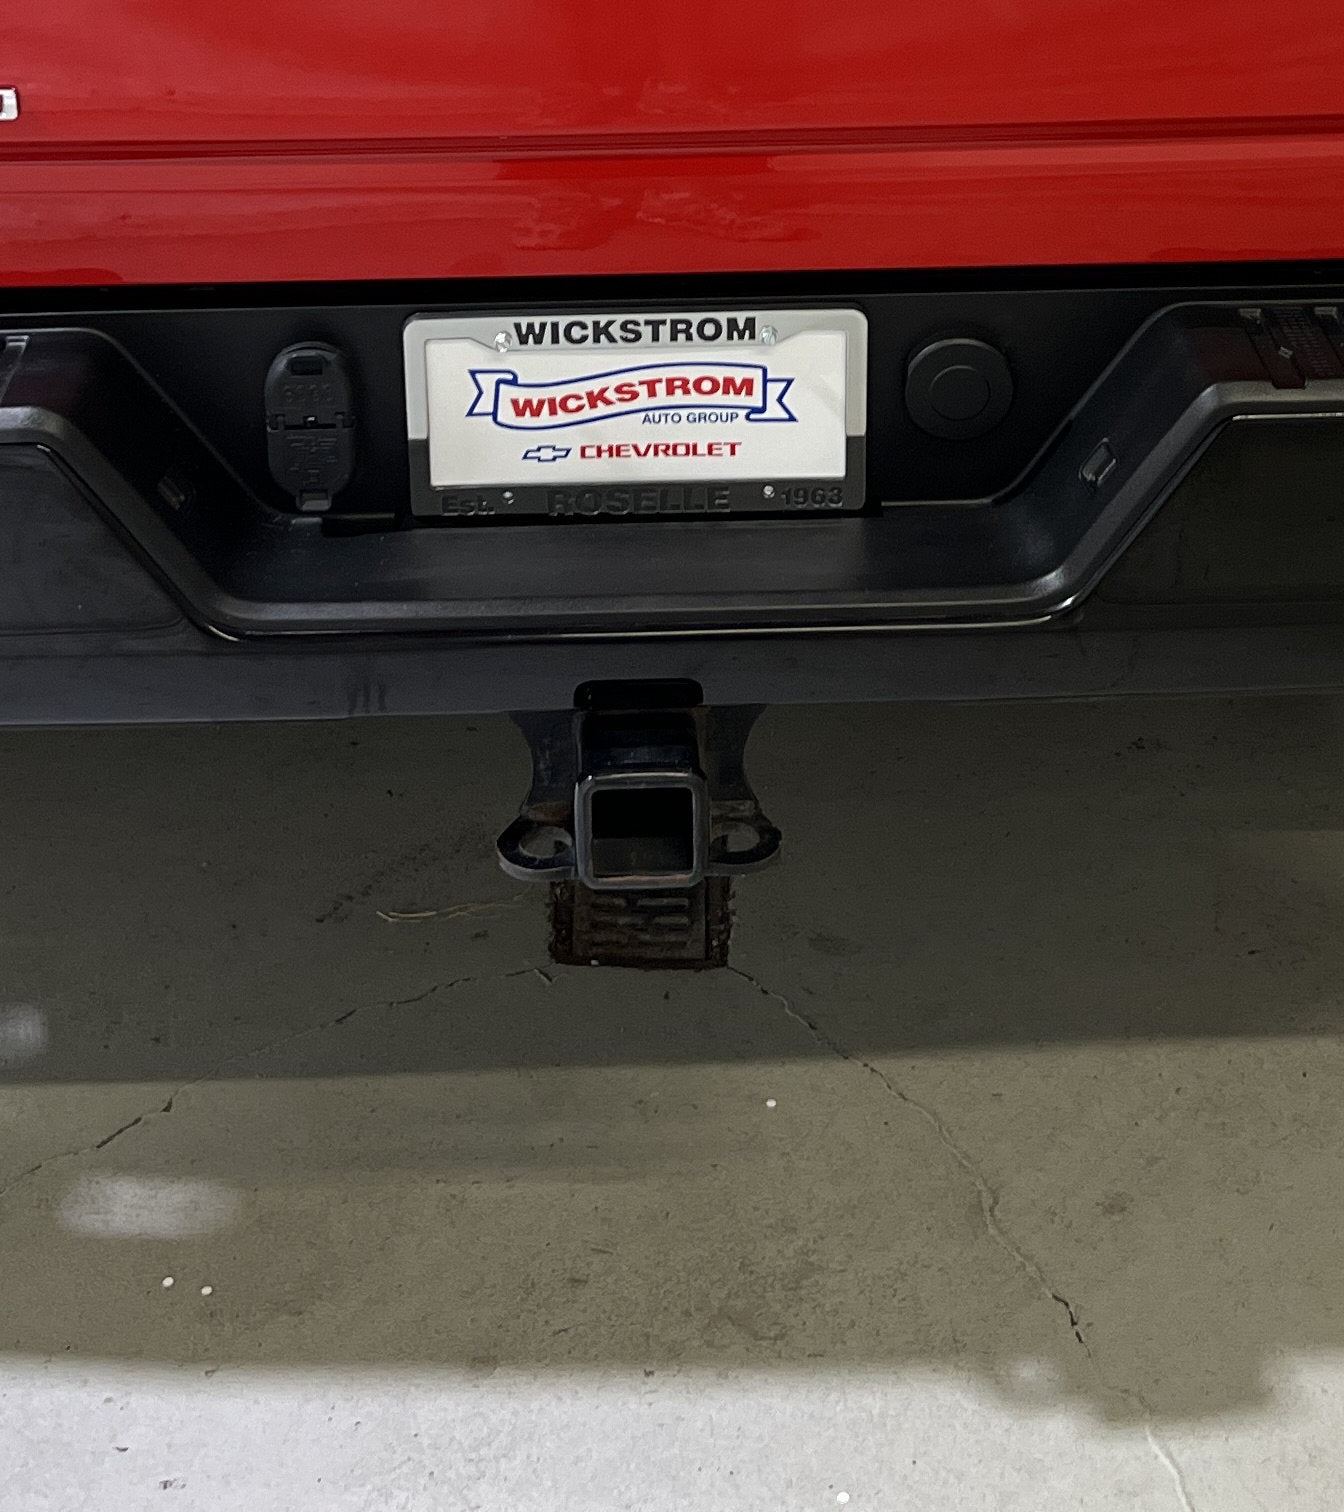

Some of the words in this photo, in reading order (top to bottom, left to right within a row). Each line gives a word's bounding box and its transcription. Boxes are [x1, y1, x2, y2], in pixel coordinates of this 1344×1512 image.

[513, 316, 758, 346] WICKSTROM
[509, 375, 755, 419] WICKSTROM
[641, 411, 682, 425] AUTO
[685, 410, 740, 424] GROUP
[579, 440, 743, 460] CHEVROLET
[440, 493, 496, 516] Est.
[546, 488, 731, 517] ROSELLE
[781, 487, 845, 508] 1963
